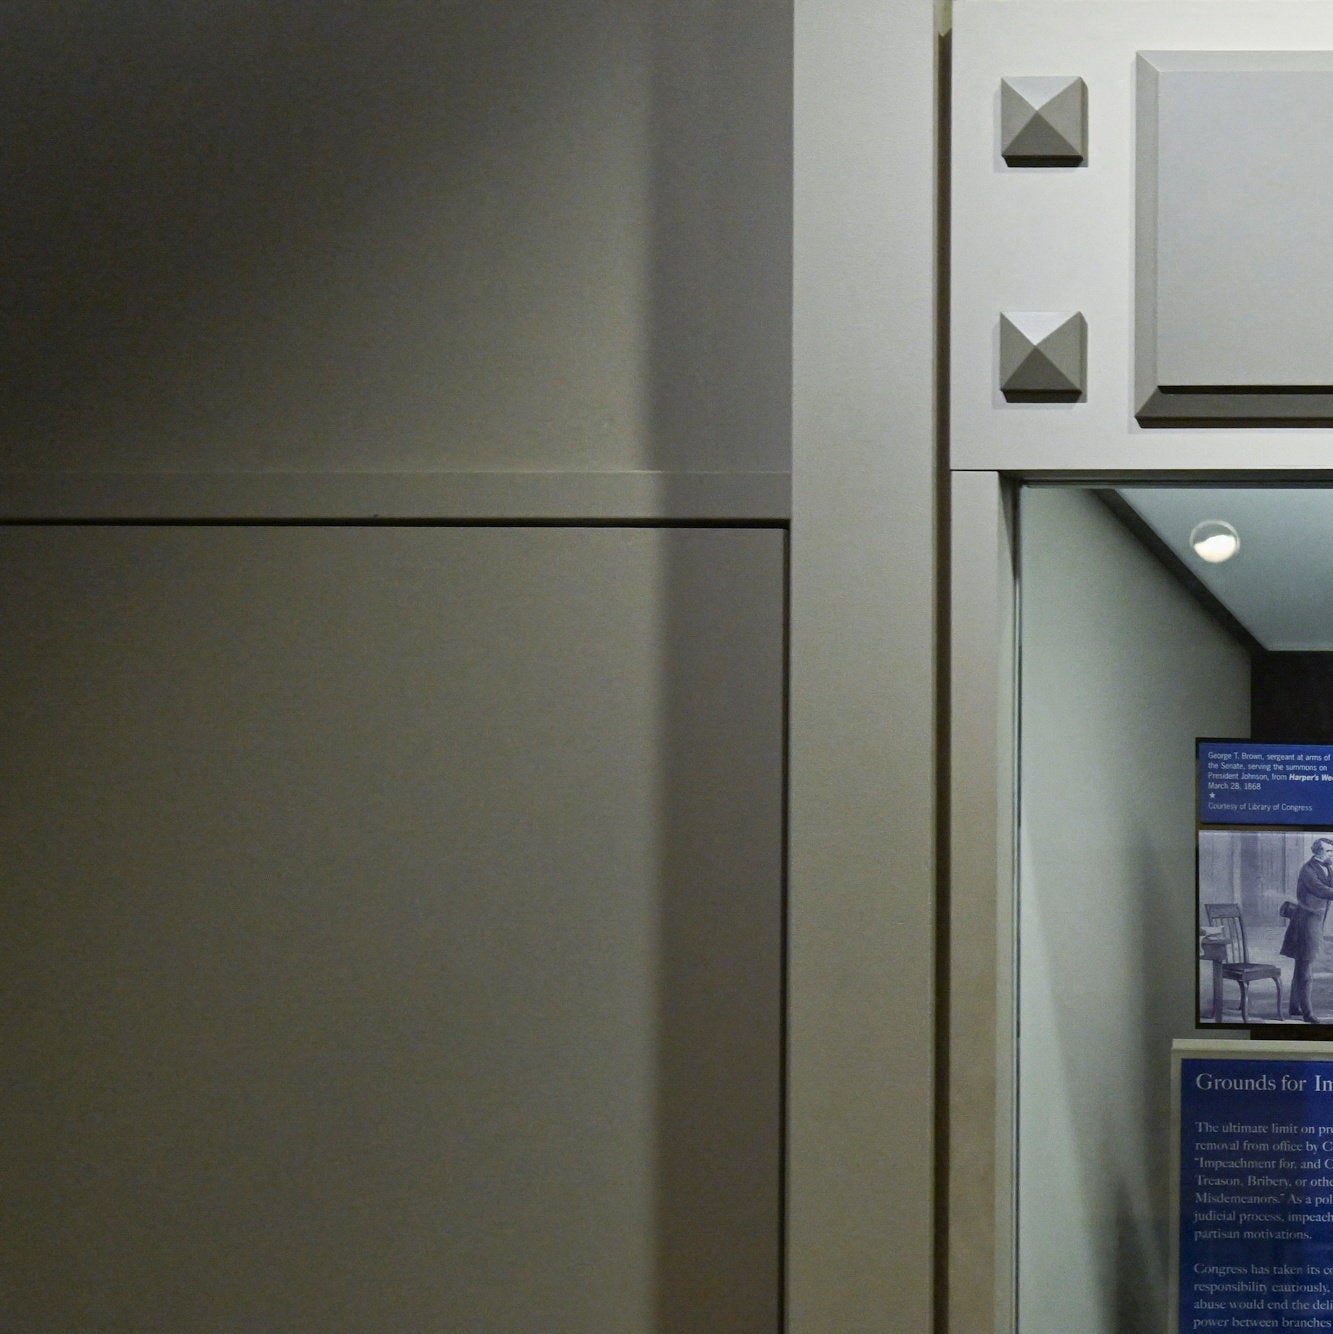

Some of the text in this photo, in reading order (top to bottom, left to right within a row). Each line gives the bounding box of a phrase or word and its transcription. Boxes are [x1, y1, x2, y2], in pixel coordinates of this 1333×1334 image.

[1208, 752, 1231, 761] George
[1266, 752, 1294, 762] sergeant
[1323, 753, 1330, 761] of
[1208, 761, 1218, 769] the
[1247, 762, 1271, 771] serving
[1208, 771, 1238, 779] President
[1271, 772, 1286, 780] from
[1288, 773, 1319, 782] Harper's
[1208, 781, 1228, 789] March
[1243, 782, 1261, 790] 1868
[1208, 802, 1237, 811] Courtesy
[1239, 802, 1246, 810] of
[1248, 802, 1270, 812] Library
[1281, 803, 1312, 812] Congress
[1196, 1073, 1276, 1090] Grounds
[1281, 1074, 1306, 1091] for
[1196, 1121, 1218, 1132] The
[1222, 1121, 1268, 1133] ultimate
[1271, 1122, 1297, 1133] limit
[1196, 1138, 1239, 1150] removal
[1242, 1139, 1268, 1150] from
[1272, 1139, 1302, 1151] office
[1305, 1140, 1318, 1154] by
[1300, 1157, 1320, 1169] and
[1294, 1178, 1307, 1186] or
[1288, 1192, 1302, 1204] As
[1305, 1196, 1311, 1204] a
[1193, 1209, 1235, 1224] judicial
[1194, 1227, 1239, 1242] partisan
[1194, 1262, 1247, 1277] Congress
[1250, 1263, 1269, 1274] has
[1272, 1263, 1302, 1274] taken
[1306, 1263, 1320, 1274] its
[1193, 1318, 1229, 1330] power
[1232, 1315, 1278, 1327] between
[1281, 1316, 1331, 1327] branches
